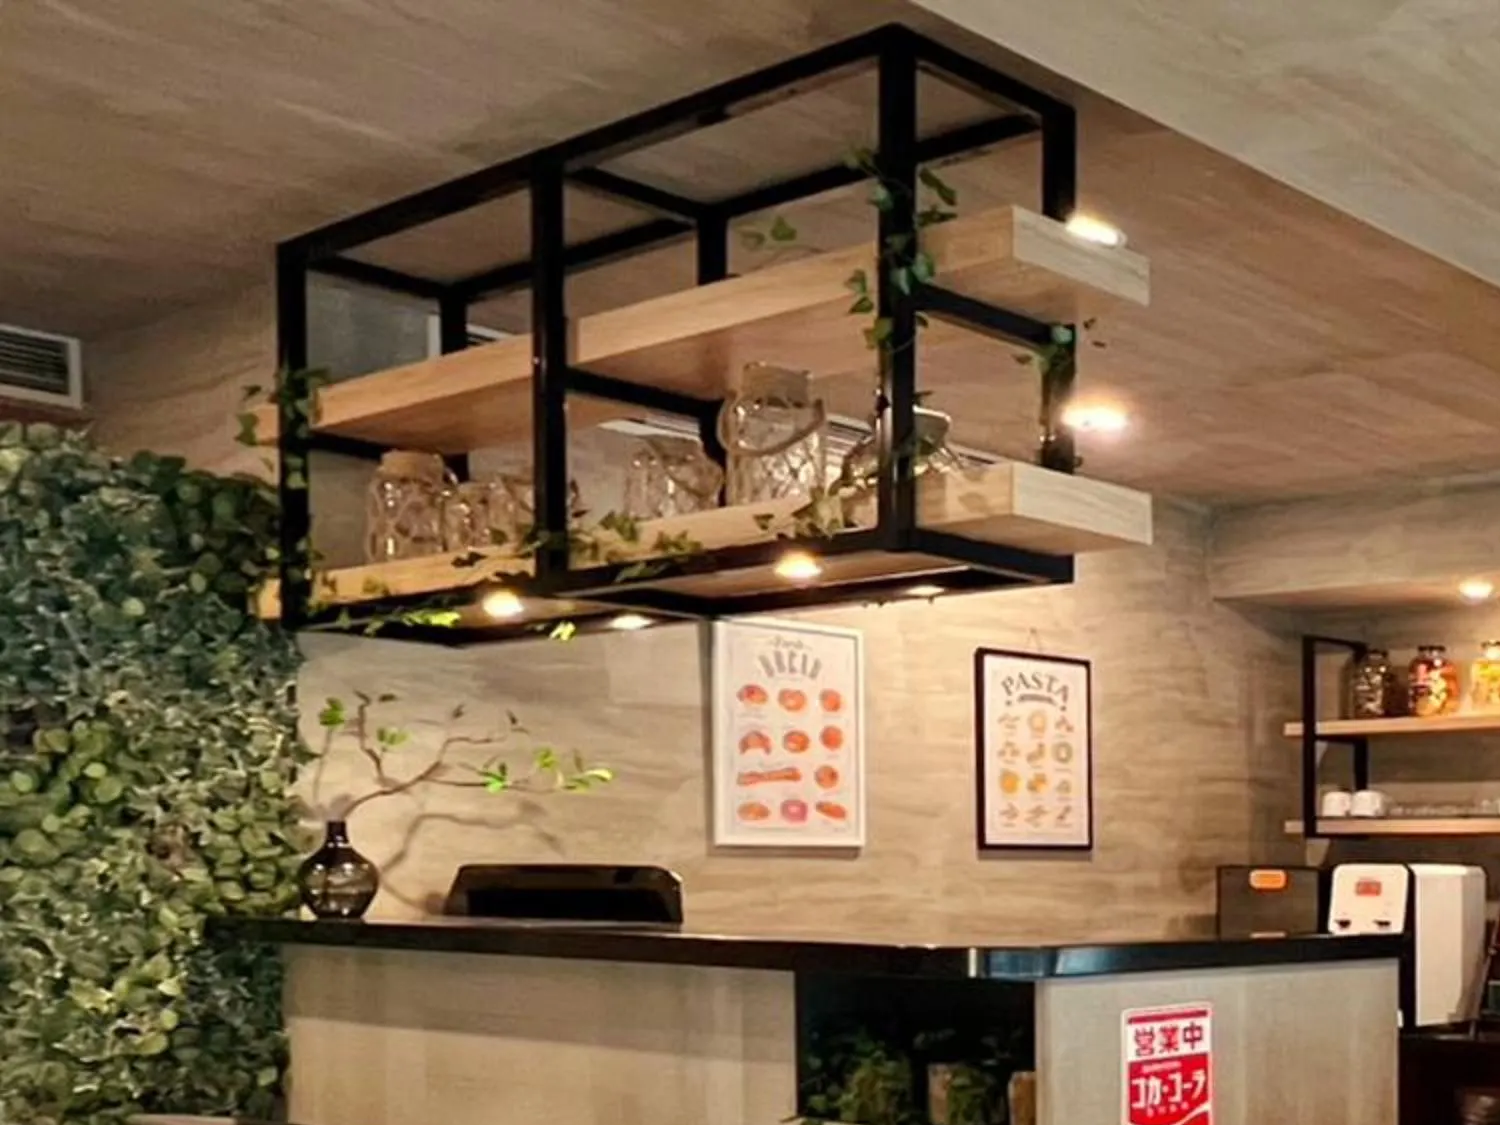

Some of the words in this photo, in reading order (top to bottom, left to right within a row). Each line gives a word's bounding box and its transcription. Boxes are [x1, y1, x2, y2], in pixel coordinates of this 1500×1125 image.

[1001, 671, 1068, 704] PASTA
[1134, 1021, 1203, 1056] 営業中
